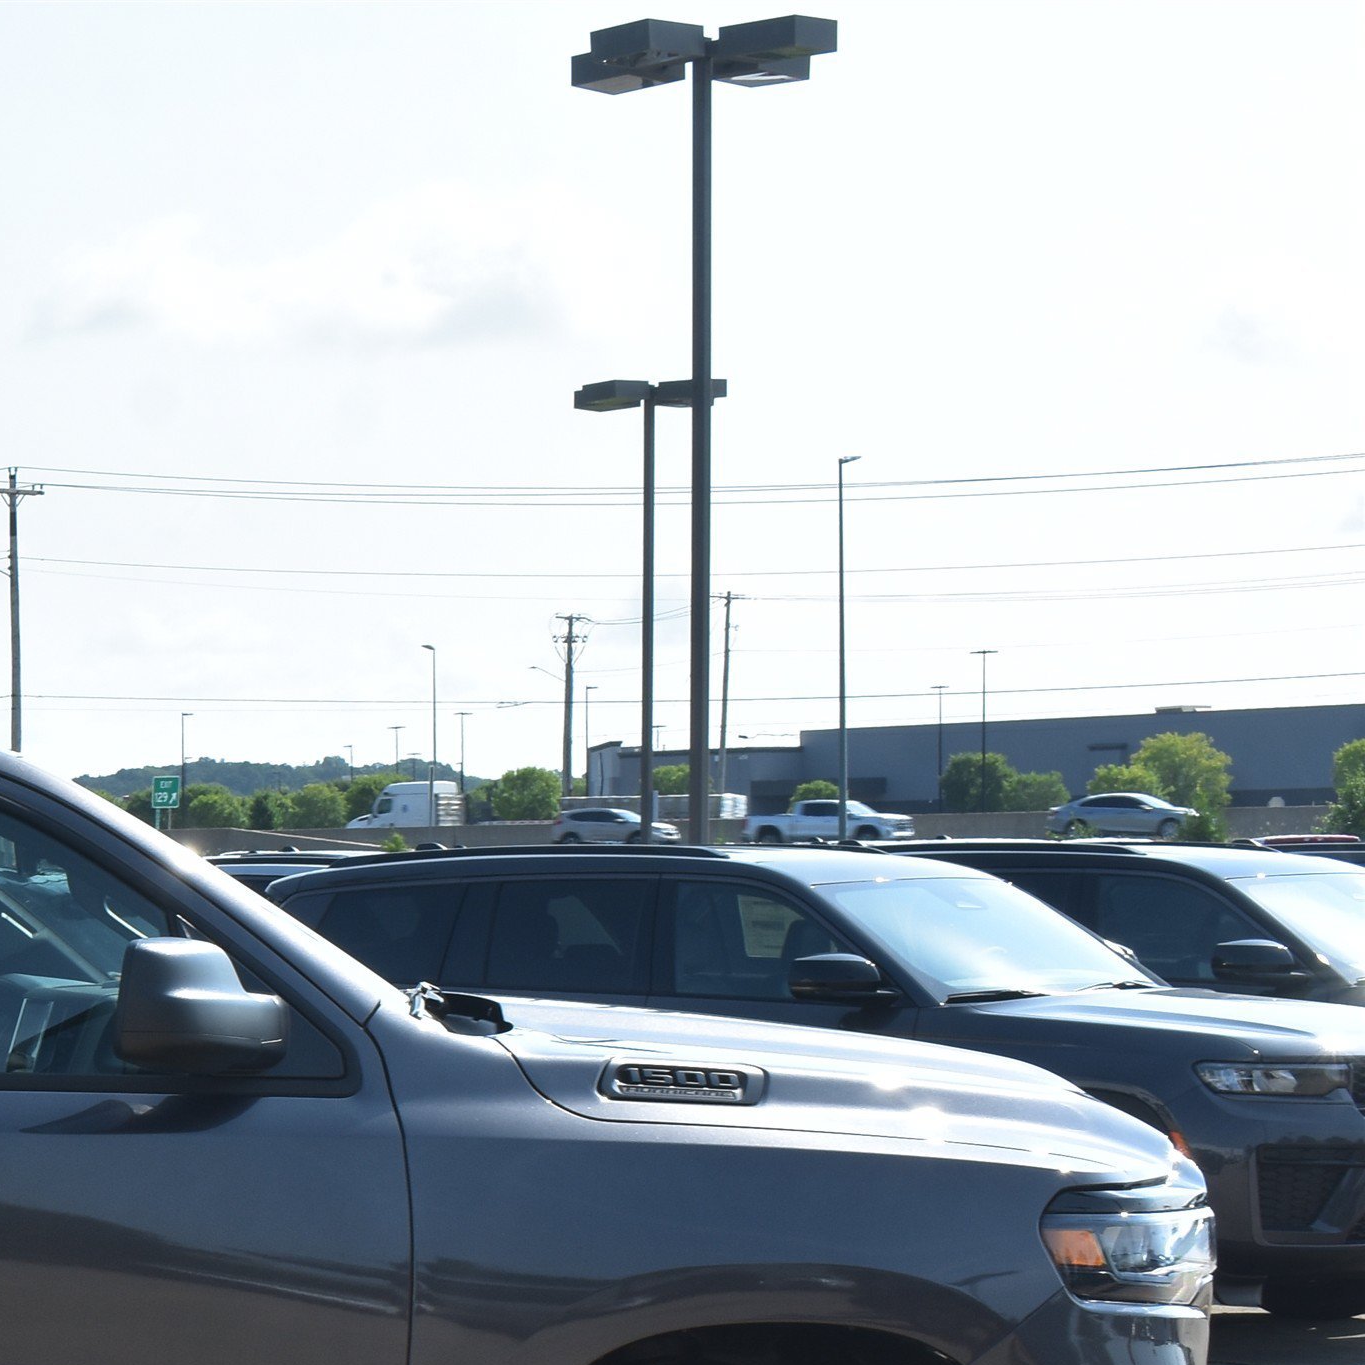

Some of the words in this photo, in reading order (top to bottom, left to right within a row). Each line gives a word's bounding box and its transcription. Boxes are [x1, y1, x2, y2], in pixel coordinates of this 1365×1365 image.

[160, 780, 173, 788] EXIT
[154, 792, 168, 802] 129
[625, 1066, 741, 1089] 1500
